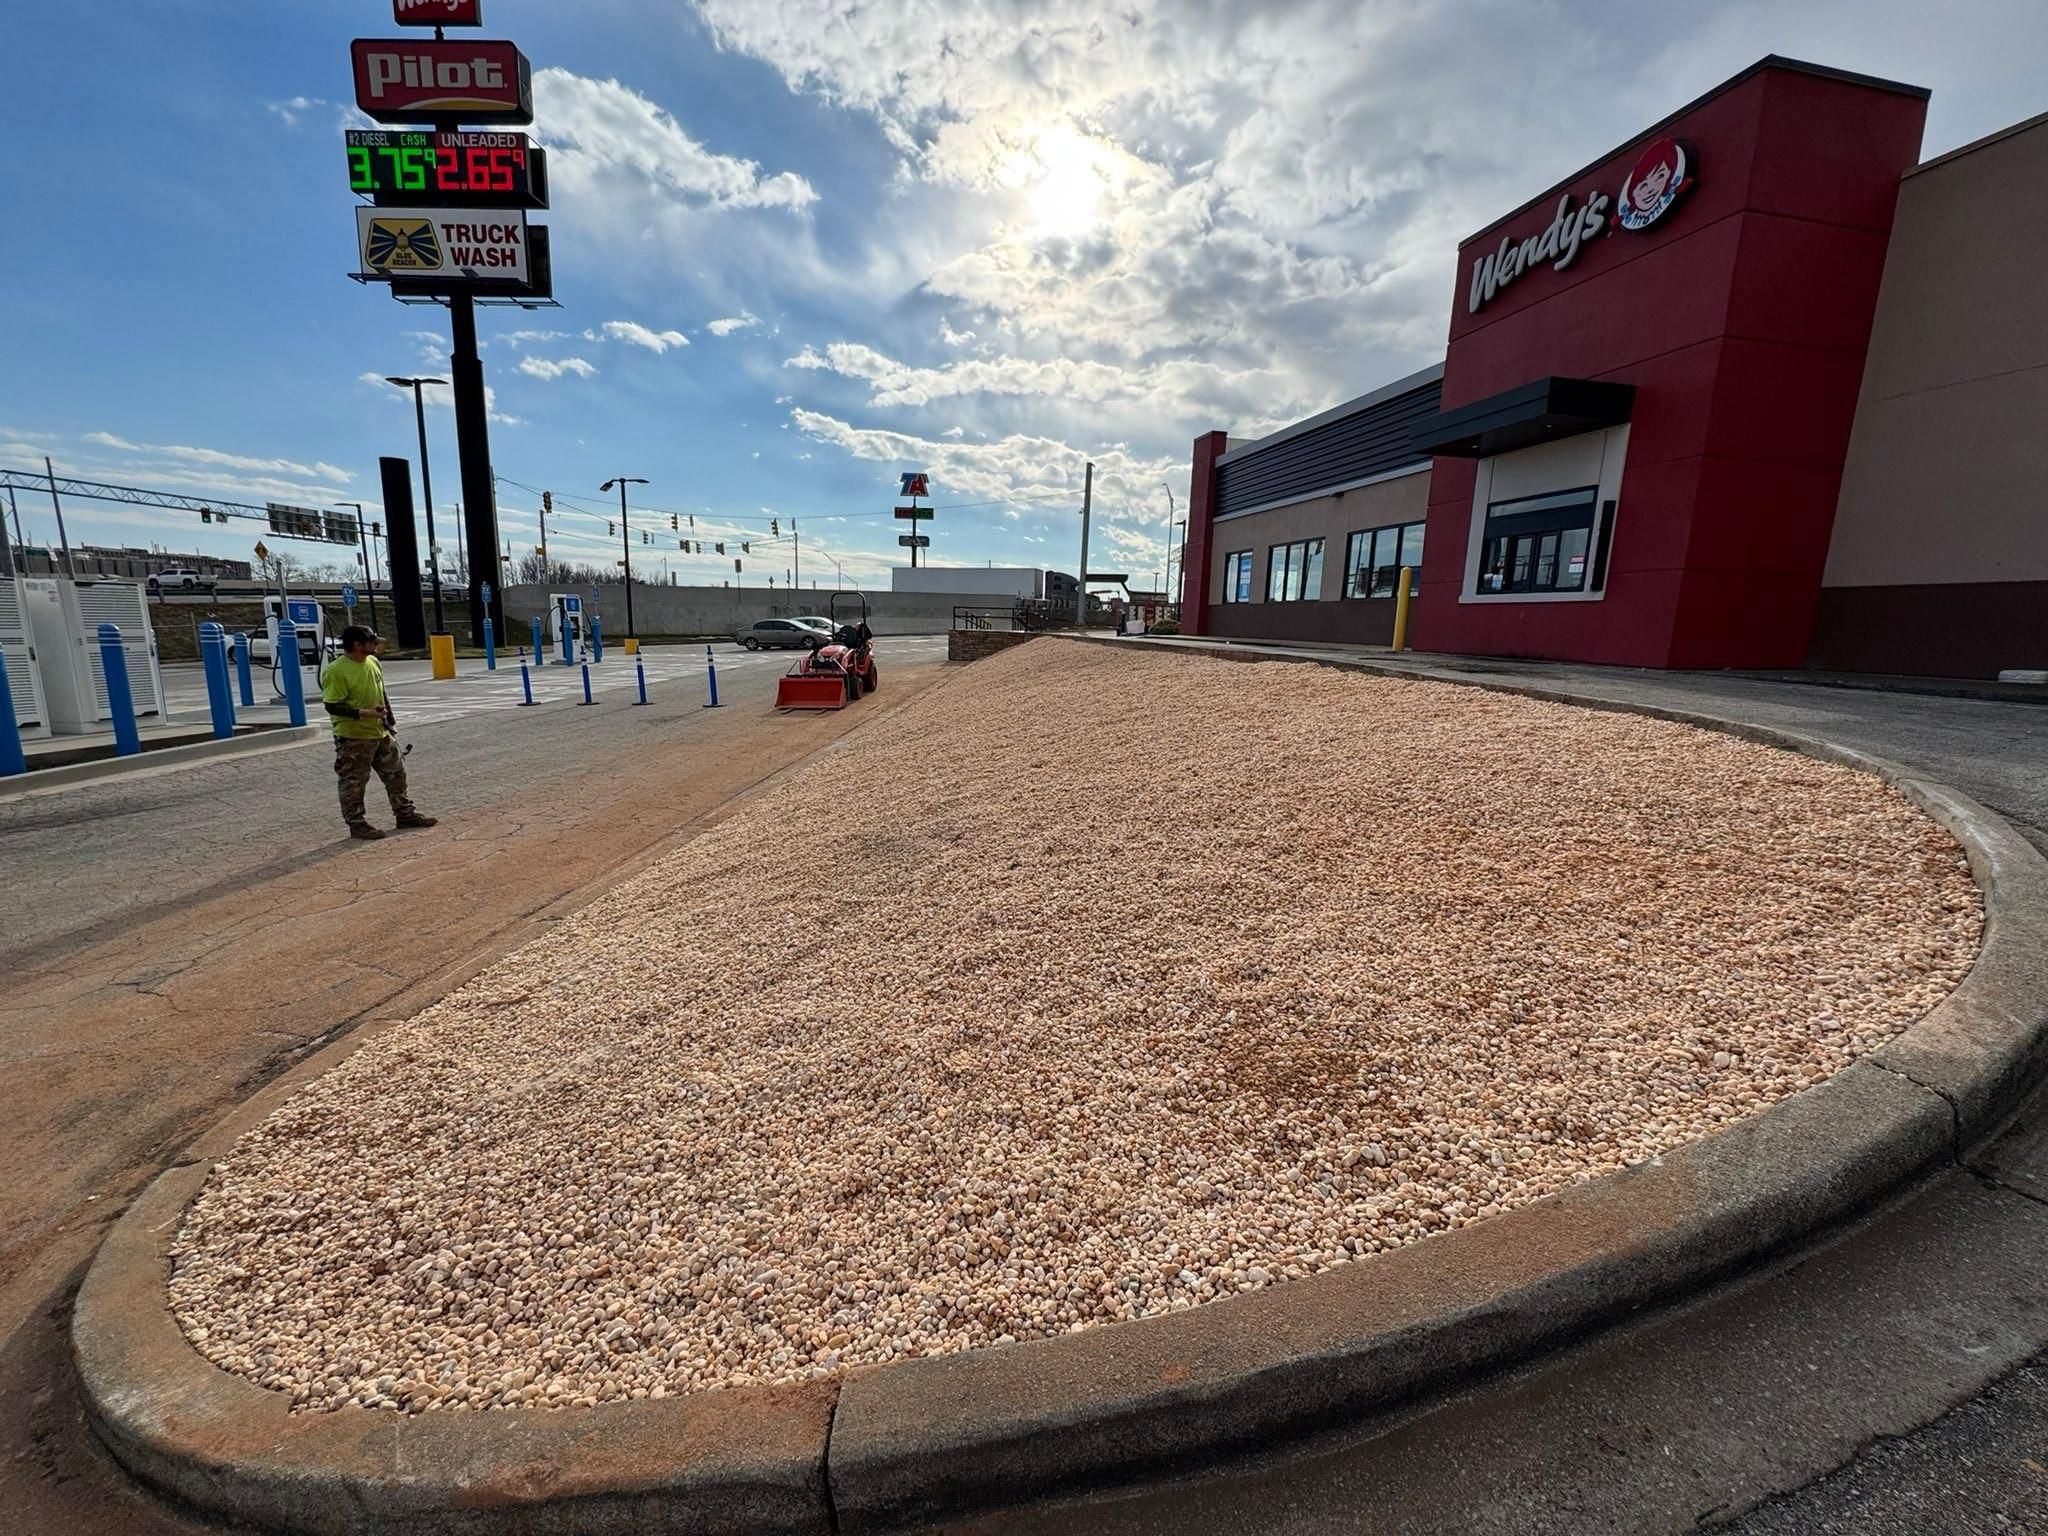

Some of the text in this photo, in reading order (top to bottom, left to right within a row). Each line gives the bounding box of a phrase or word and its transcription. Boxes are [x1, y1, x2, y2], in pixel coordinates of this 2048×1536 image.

[367, 53, 504, 98] Pilot
[350, 133, 427, 147] #2 DIESEL CASH
[441, 134, 517, 148] UNLEADED
[441, 223, 521, 244] TRUCK
[450, 247, 516, 267] WASH
[1468, 190, 1609, 313] Wendy's
[900, 472, 930, 497] TA
